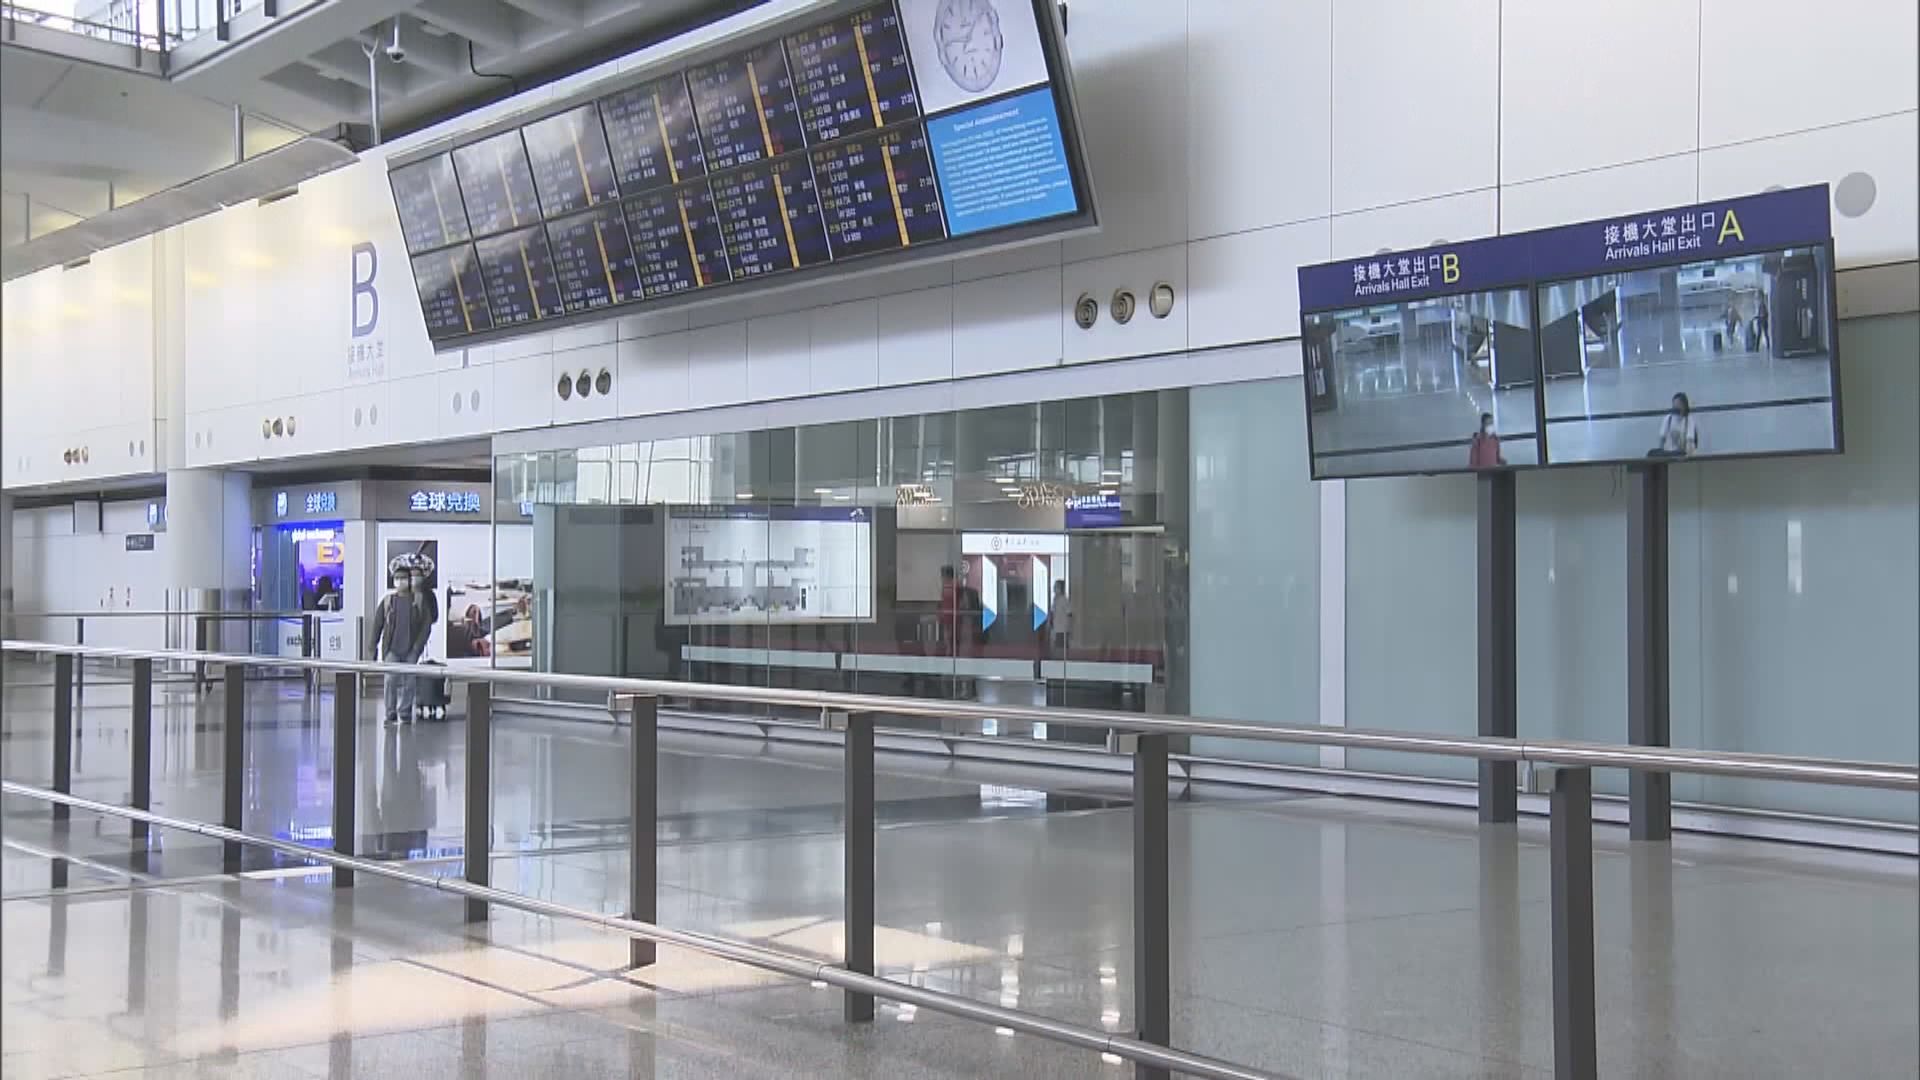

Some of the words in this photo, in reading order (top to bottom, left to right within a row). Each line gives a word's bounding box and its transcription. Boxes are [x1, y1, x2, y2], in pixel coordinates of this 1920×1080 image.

[1604, 212, 1715, 245] 接機大堂出口
[1717, 209, 1744, 245] A
[1605, 243, 1649, 261] Arrivals
[1652, 238, 1675, 254] Hall
[1678, 234, 1701, 250] Exit
[1353, 254, 1440, 283] 接機大堂出口
[1442, 253, 1460, 283] B
[352, 242, 378, 338] B
[1355, 280, 1390, 297] Arrivals
[1391, 277, 1410, 292] Hall
[1411, 274, 1430, 289] Exit
[411, 490, 480, 511] 全球兌換
